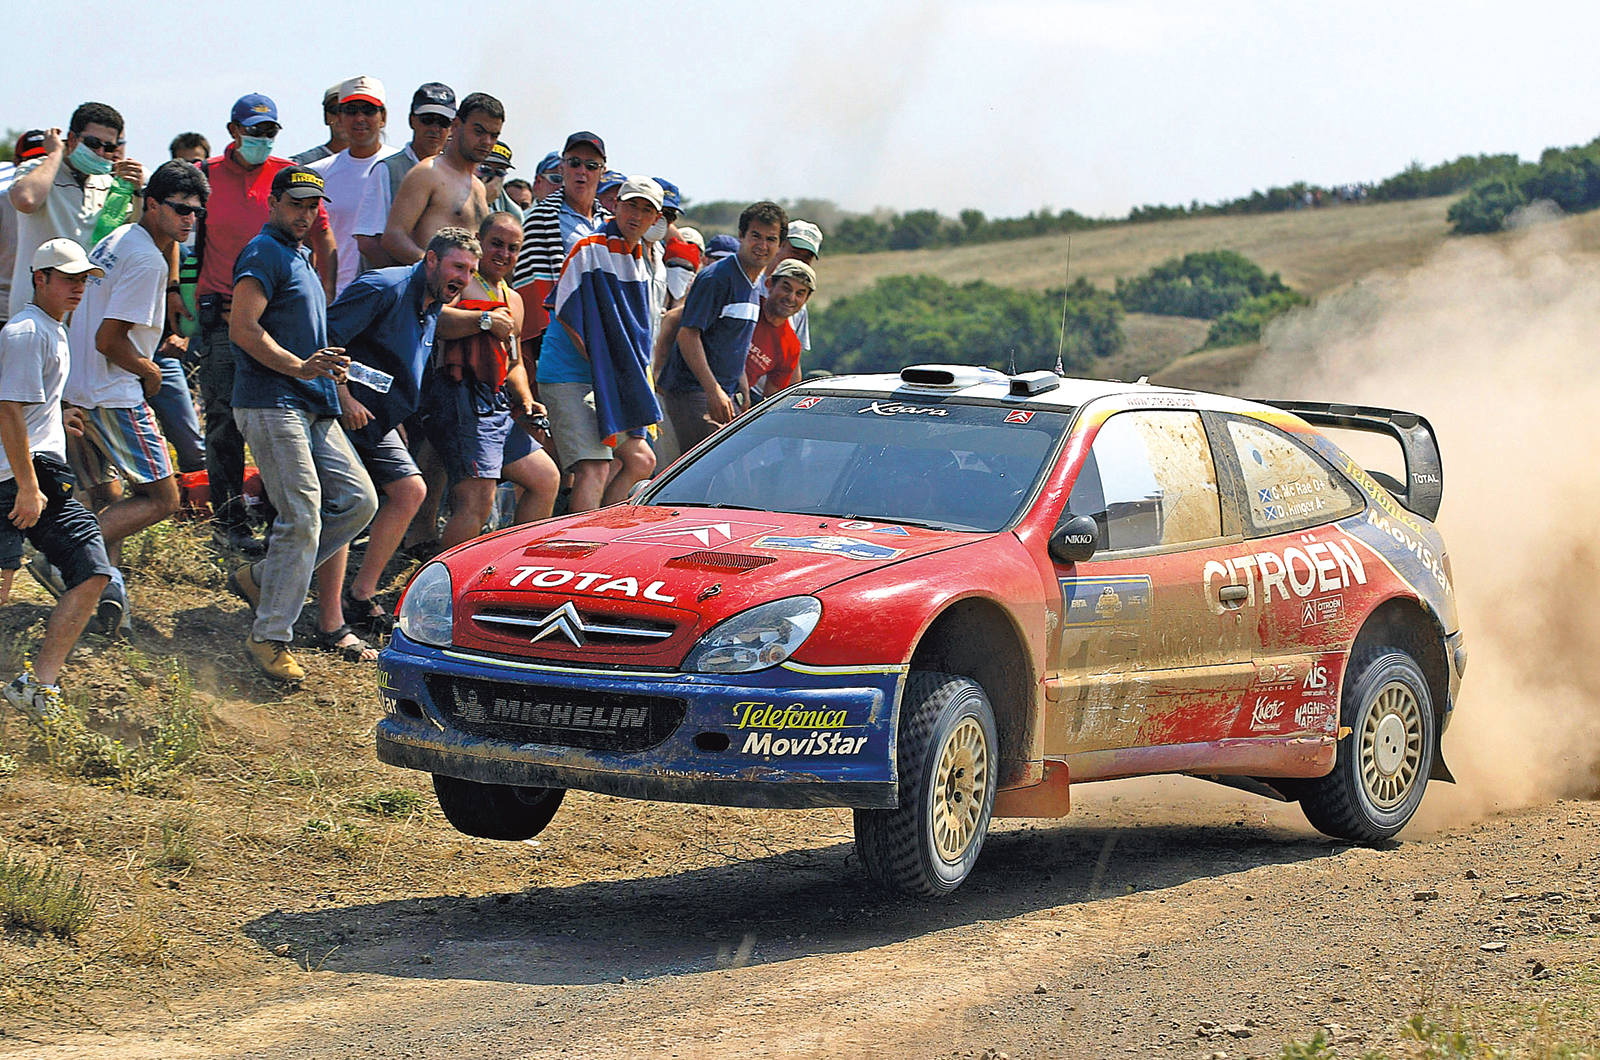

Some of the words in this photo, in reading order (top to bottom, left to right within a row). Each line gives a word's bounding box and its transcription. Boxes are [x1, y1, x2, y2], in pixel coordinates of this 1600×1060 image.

[1412, 472, 1439, 484] TOTAL
[1064, 533, 1093, 545] NIKKO
[508, 565, 676, 603] TOTAL
[1203, 534, 1368, 616] CITROËN
[492, 697, 649, 728] MICHELIN
[741, 731, 868, 756] MoviStar
